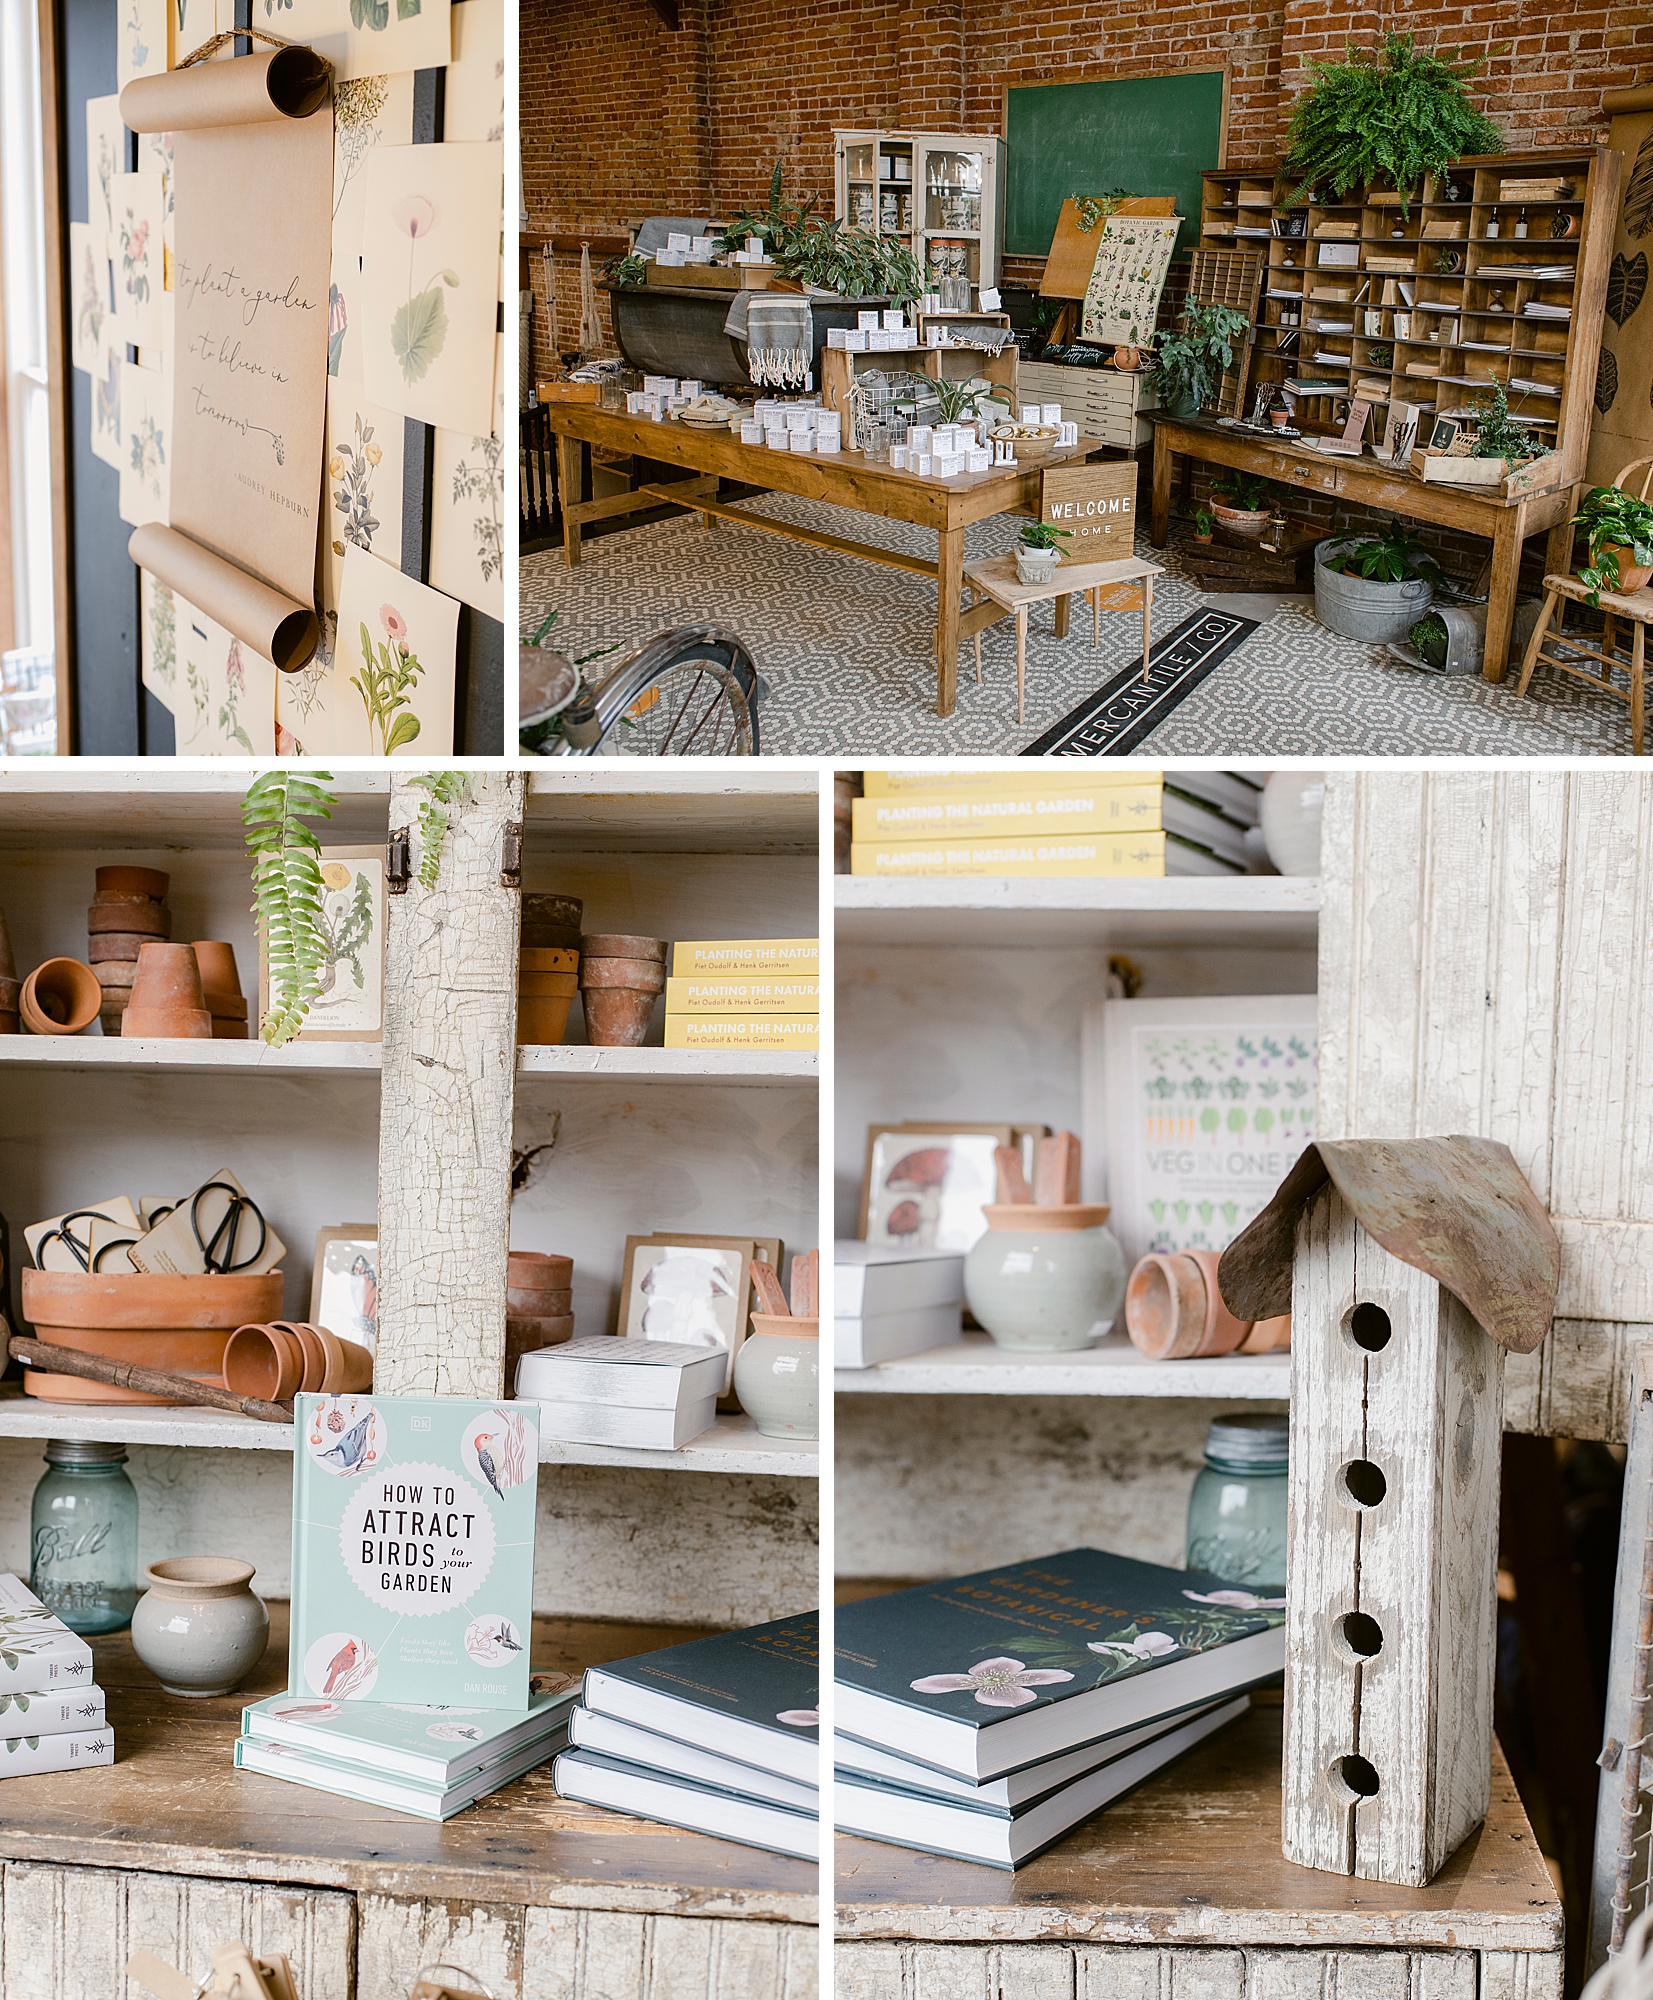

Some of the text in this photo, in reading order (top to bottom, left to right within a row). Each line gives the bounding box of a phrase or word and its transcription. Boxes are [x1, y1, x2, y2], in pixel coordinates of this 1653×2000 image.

[187, 263, 241, 309] plant
[240, 286, 251, 297] a
[243, 276, 317, 326] garden
[198, 331, 215, 360] to
[219, 335, 266, 372] believe
[272, 367, 289, 383] in
[192, 383, 250, 436] tomorrow
[270, 490, 310, 518] HEPBURN
[1051, 497, 1131, 519] WELCOME
[1069, 524, 1112, 537] HOME
[1061, 653, 1193, 756] MERCANTILE
[1197, 621, 1232, 642] CO.
[876, 805, 943, 822] PLANTING
[945, 803, 970, 819] THE
[972, 801, 1034, 817] NATURAL
[1035, 798, 1095, 814] GARDEN
[876, 850, 944, 867] PLANTING
[945, 849, 970, 864] THE
[972, 847, 1035, 863] NATURAL
[1037, 845, 1096, 861] GARDEN
[694, 948, 819, 960] PLANTING THE NATUR
[708, 962, 731, 970] Oudolf
[688, 986, 747, 996] PLANTING
[750, 985, 771, 996] THE
[686, 1023, 747, 1034] PLANTING
[749, 1023, 771, 1034] THE
[1145, 1150, 1195, 1175] VEG
[1198, 1151, 1223, 1175] IN
[1226, 1151, 1282, 1176] ONE
[383, 1484, 455, 1506] HOW TO
[362, 1509, 475, 1539] ATTRACT
[36, 1521, 112, 1570] Ball
[361, 1540, 464, 1568] BIRDS to
[439, 1560, 473, 1570] your
[381, 1572, 452, 1594] GARDEN
[1023, 1569, 1075, 1587] THE
[954, 1585, 1101, 1631] BOTANICAL
[989, 1577, 1157, 1625] GARDENER'S
[399, 1637, 452, 1647] Foods they like
[399, 1646, 454, 1656] Plants they love
[424, 1656, 440, 1665] they
[441, 1658, 459, 1666] need
[464, 1682, 508, 1695] DAN ROUSE
